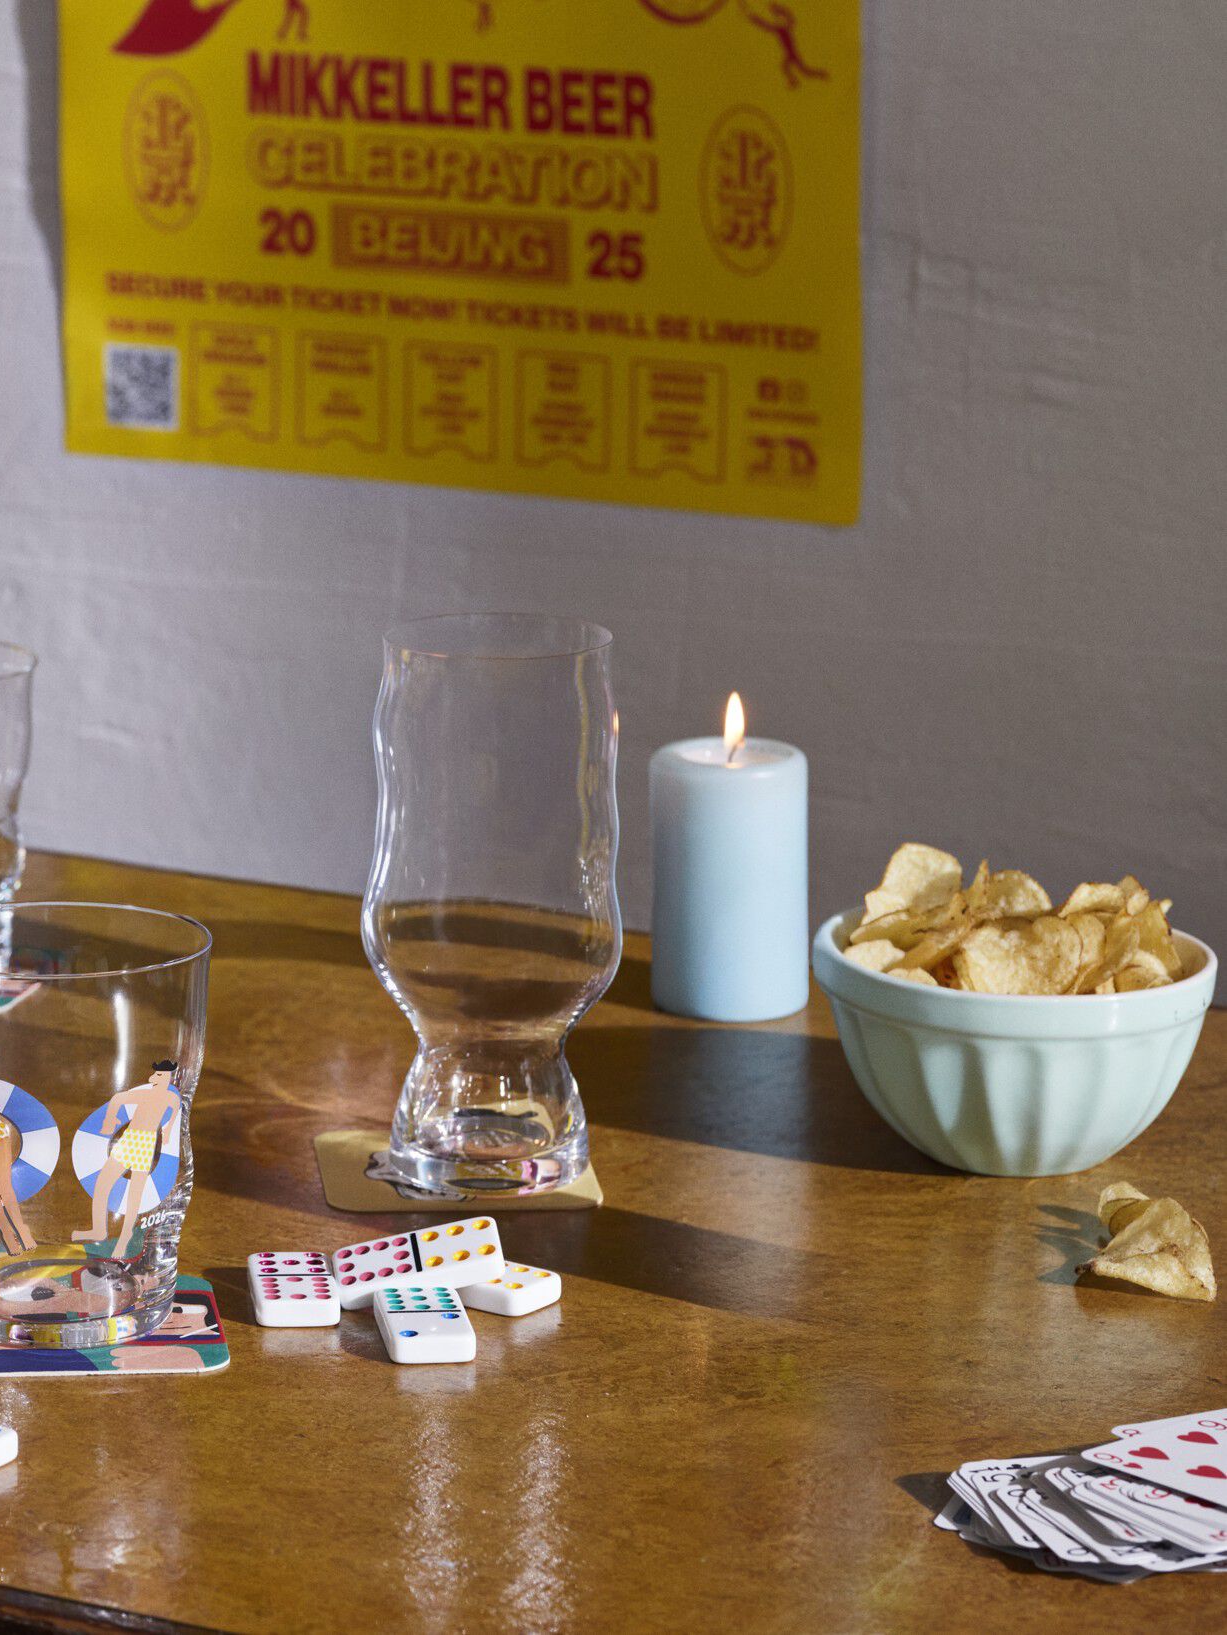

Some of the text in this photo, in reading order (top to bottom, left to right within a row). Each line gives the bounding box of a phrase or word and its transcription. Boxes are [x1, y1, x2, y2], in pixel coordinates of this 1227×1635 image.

[247, 50, 654, 139] MIKKELLER BEER
[247, 127, 659, 214] CELEBRATION
[259, 208, 645, 281] 20 BEIJING 25
[106, 272, 205, 302] SECURE
[215, 280, 284, 308] YOUR
[292, 285, 382, 316] TICKET
[466, 299, 578, 332] TICKETS
[585, 311, 649, 339] WILL
[655, 315, 691, 342] BE
[140, 1210, 166, 1229] 2026
